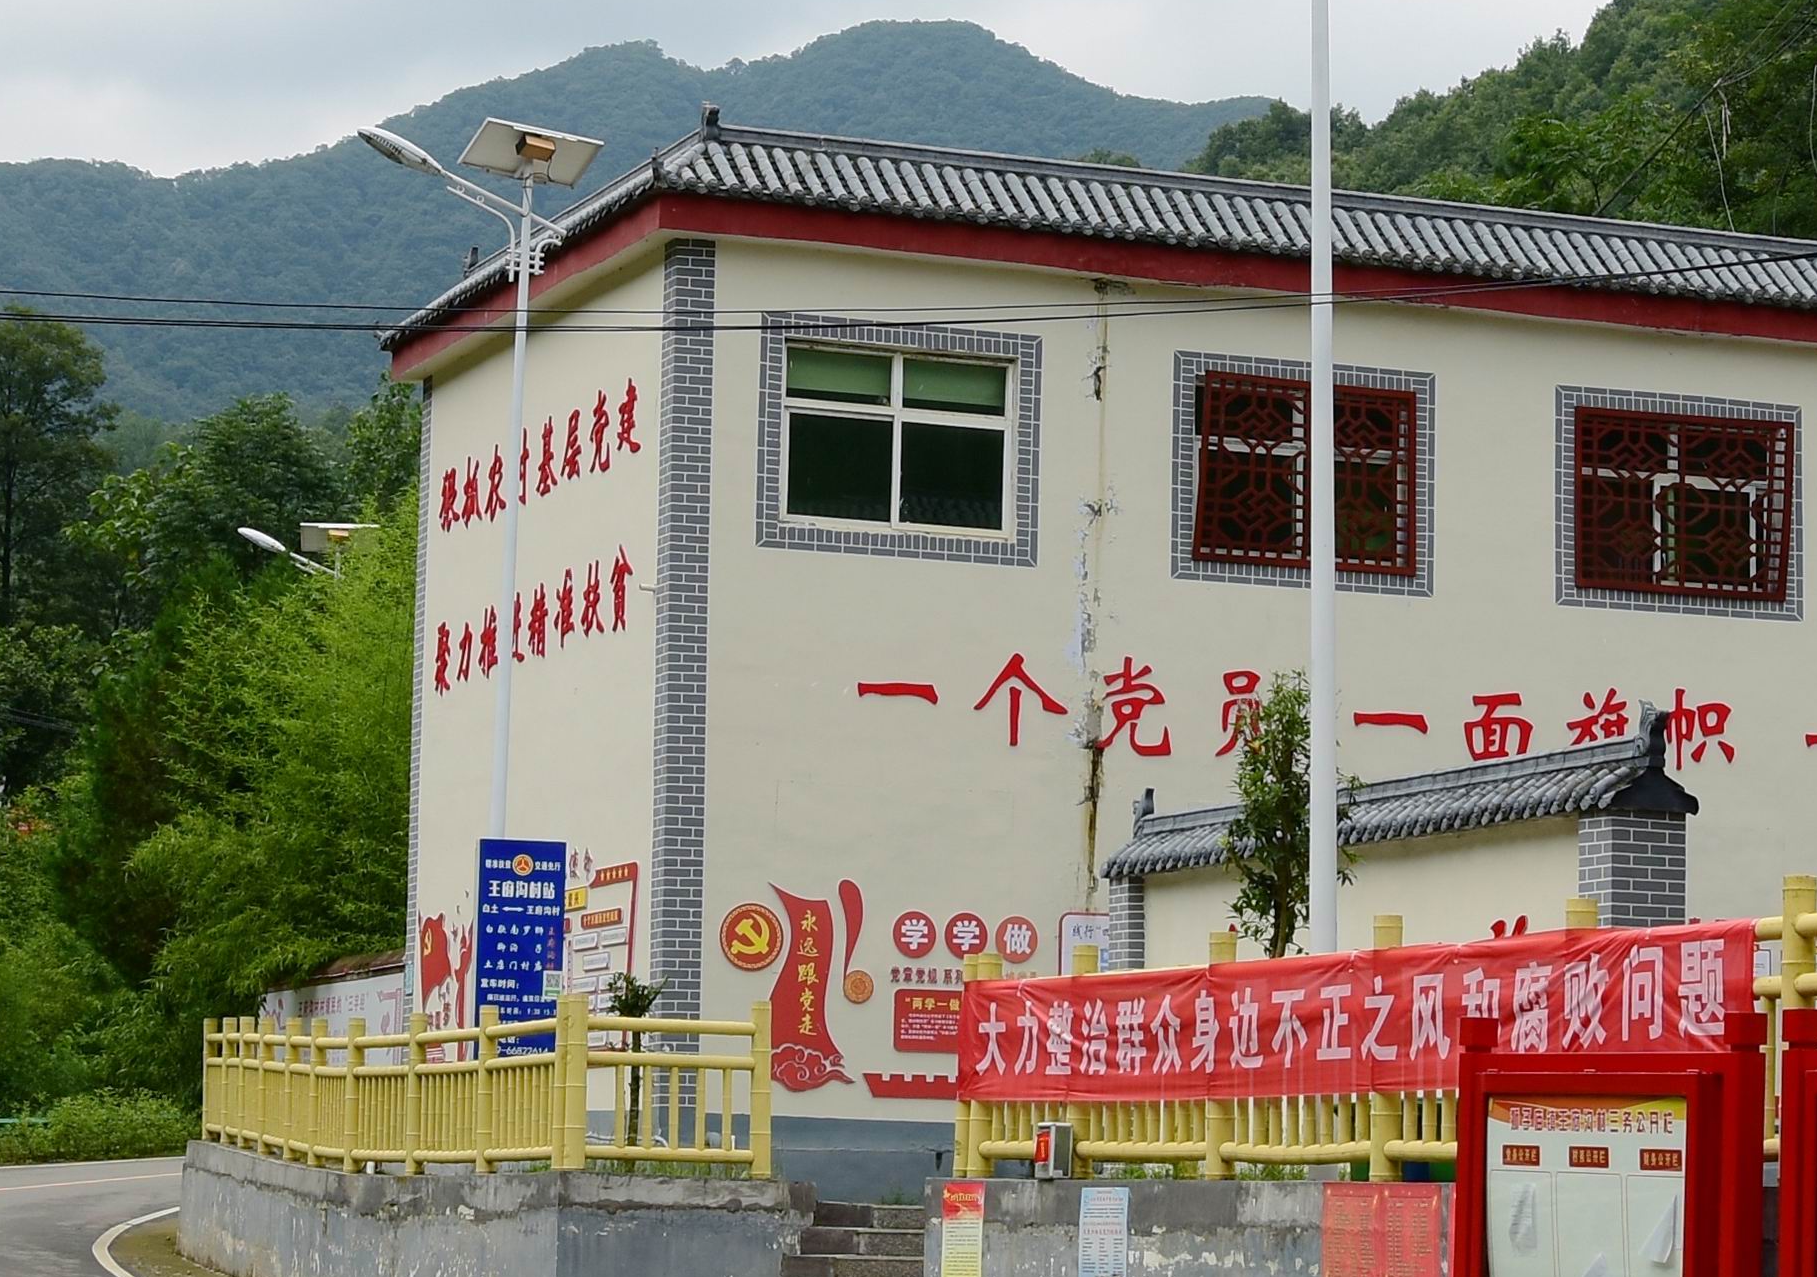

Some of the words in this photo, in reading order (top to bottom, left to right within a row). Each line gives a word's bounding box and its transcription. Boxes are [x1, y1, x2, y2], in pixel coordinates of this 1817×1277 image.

[488, 880, 555, 899] 王府沟村站
[482, 904, 499, 914] 白土
[901, 919, 928, 950] 学
[953, 919, 980, 951] 学
[1003, 924, 1031, 954] 做
[976, 938, 1725, 1077] 大力整治群众身边不正之风和腐败问题
[1510, 1107, 1673, 1134] 狮子庙镇王府沟村三务公开栏
